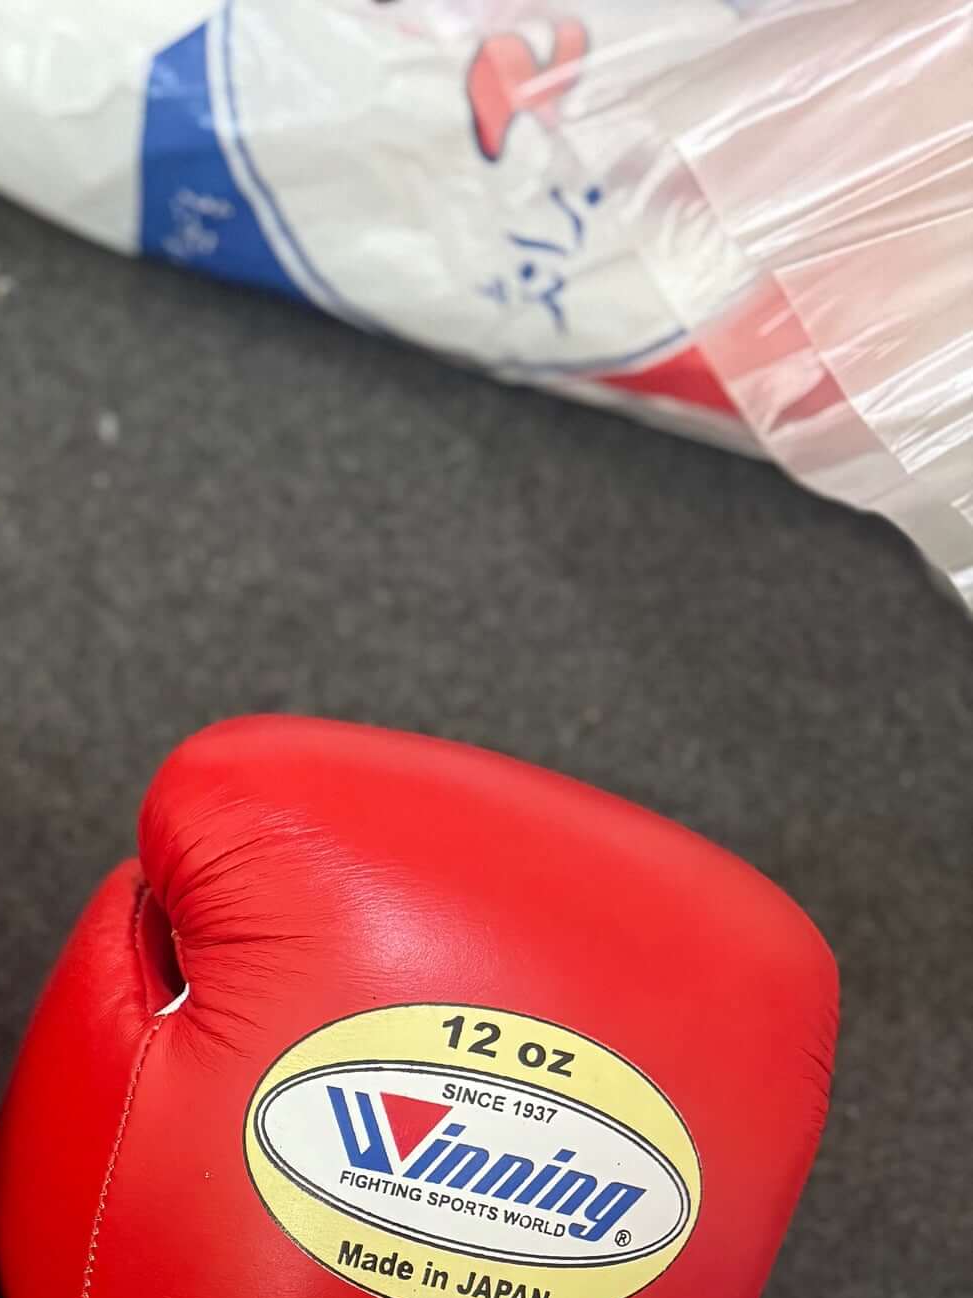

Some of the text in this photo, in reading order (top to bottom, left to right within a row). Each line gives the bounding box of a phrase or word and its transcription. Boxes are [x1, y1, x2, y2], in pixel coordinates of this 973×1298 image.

[441, 1015, 576, 1078] 12 oz
[442, 1083, 559, 1125] SINCE 1937
[326, 1085, 647, 1242] Winning
[339, 1170, 566, 1238] FIGHTING SPORTS WORLD
[337, 1240, 415, 1282] Made
[421, 1261, 448, 1289] in
